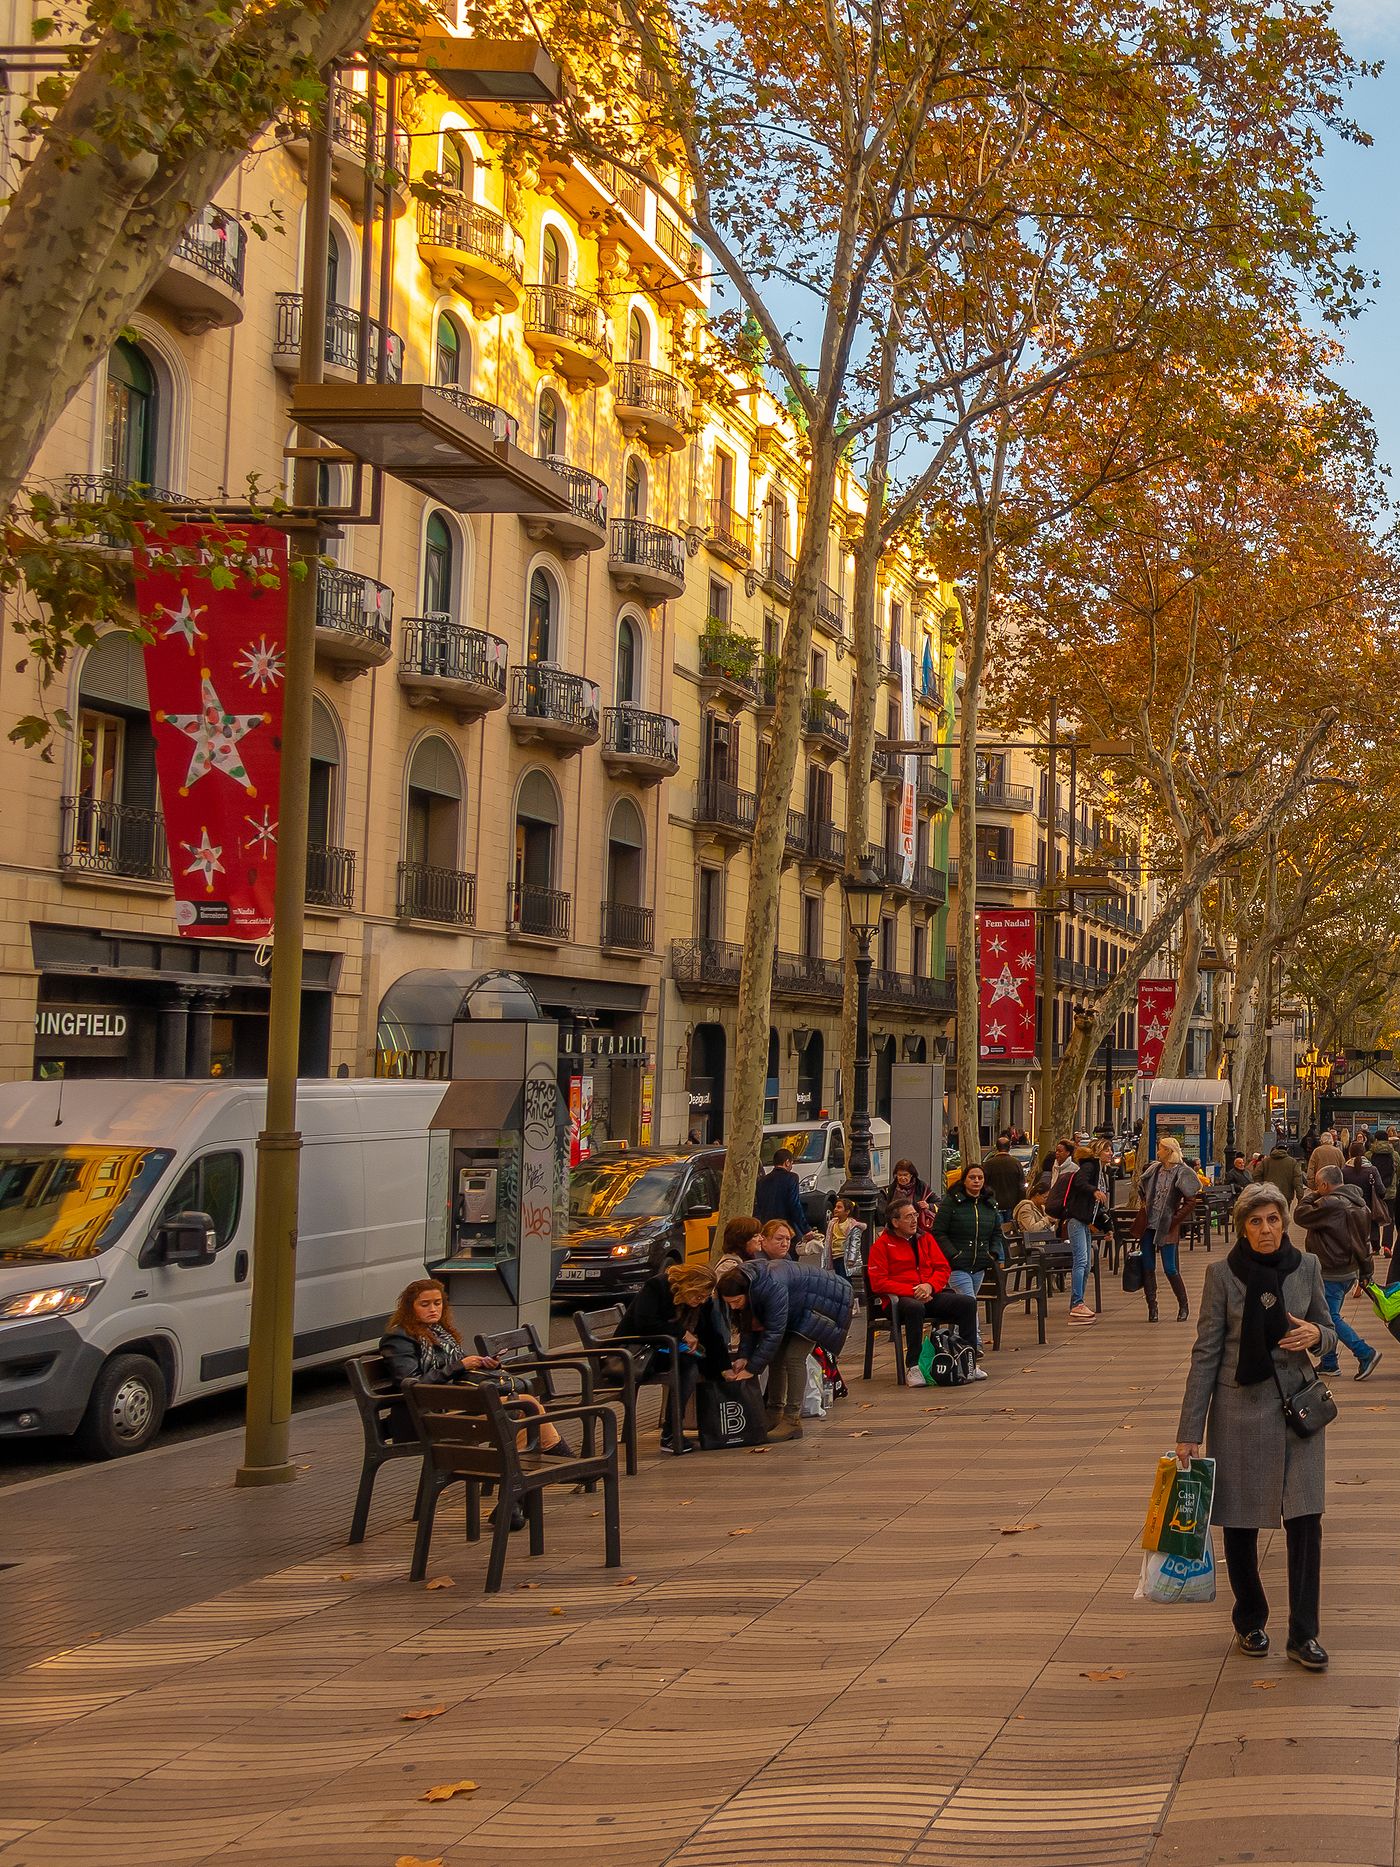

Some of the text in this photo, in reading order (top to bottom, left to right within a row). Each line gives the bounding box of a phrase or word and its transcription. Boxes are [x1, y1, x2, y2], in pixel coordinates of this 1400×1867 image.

[985, 919, 1031, 928] Fem Nadal!
[720, 1401, 746, 1436] B
[1178, 1489, 1195, 1500] Casa
